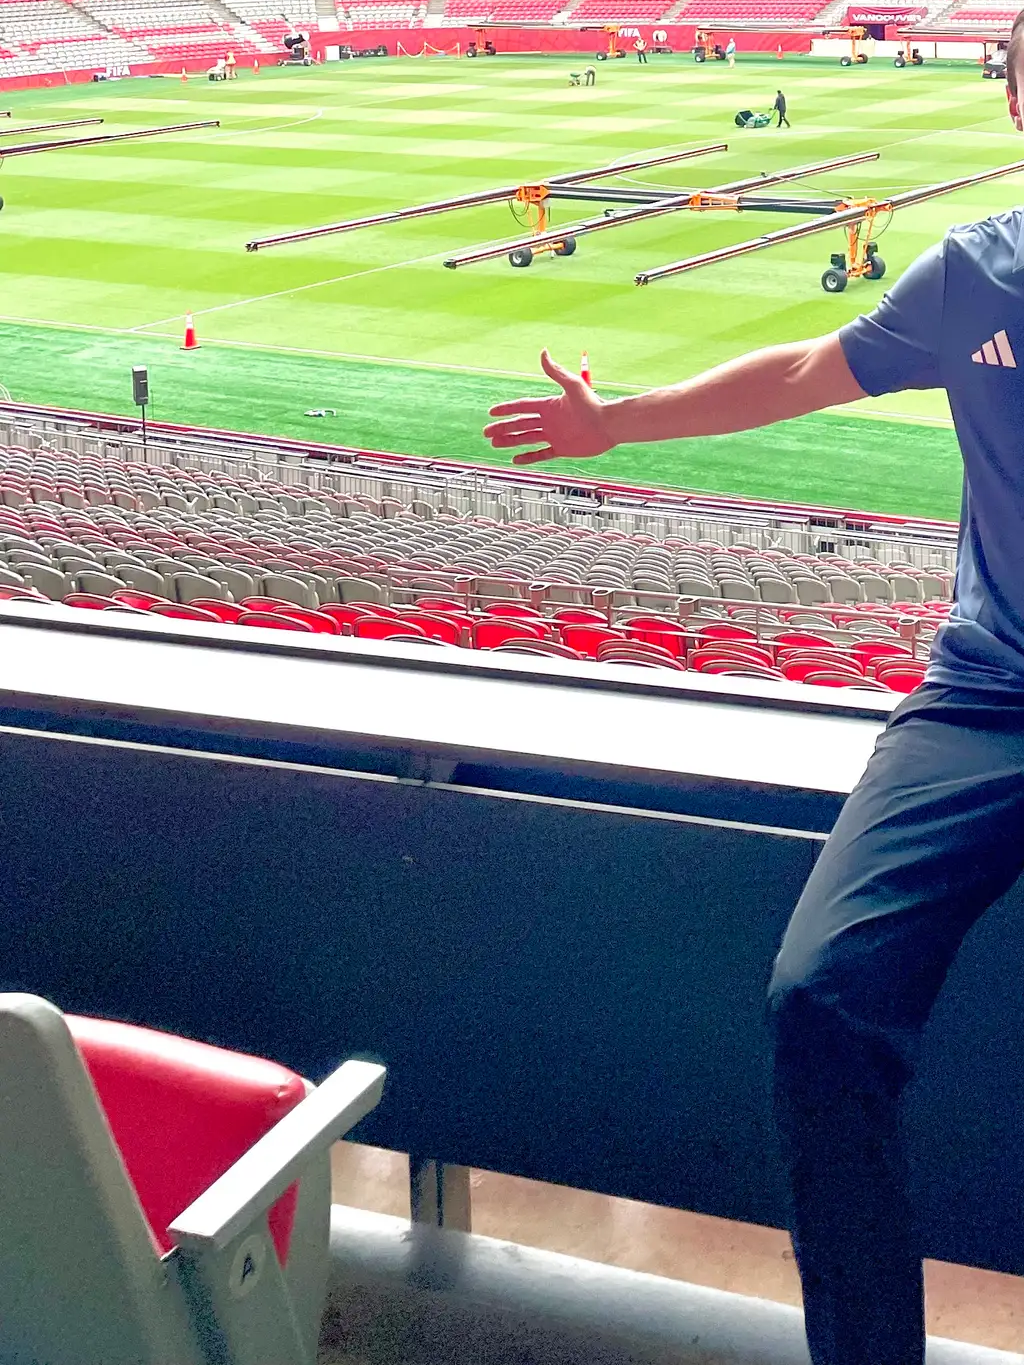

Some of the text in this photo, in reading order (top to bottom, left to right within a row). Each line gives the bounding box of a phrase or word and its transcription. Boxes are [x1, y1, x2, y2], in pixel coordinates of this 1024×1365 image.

[852, 13, 922, 22] VANCOUVER
[617, 27, 641, 38] FIFA
[106, 65, 131, 78] FIFA
